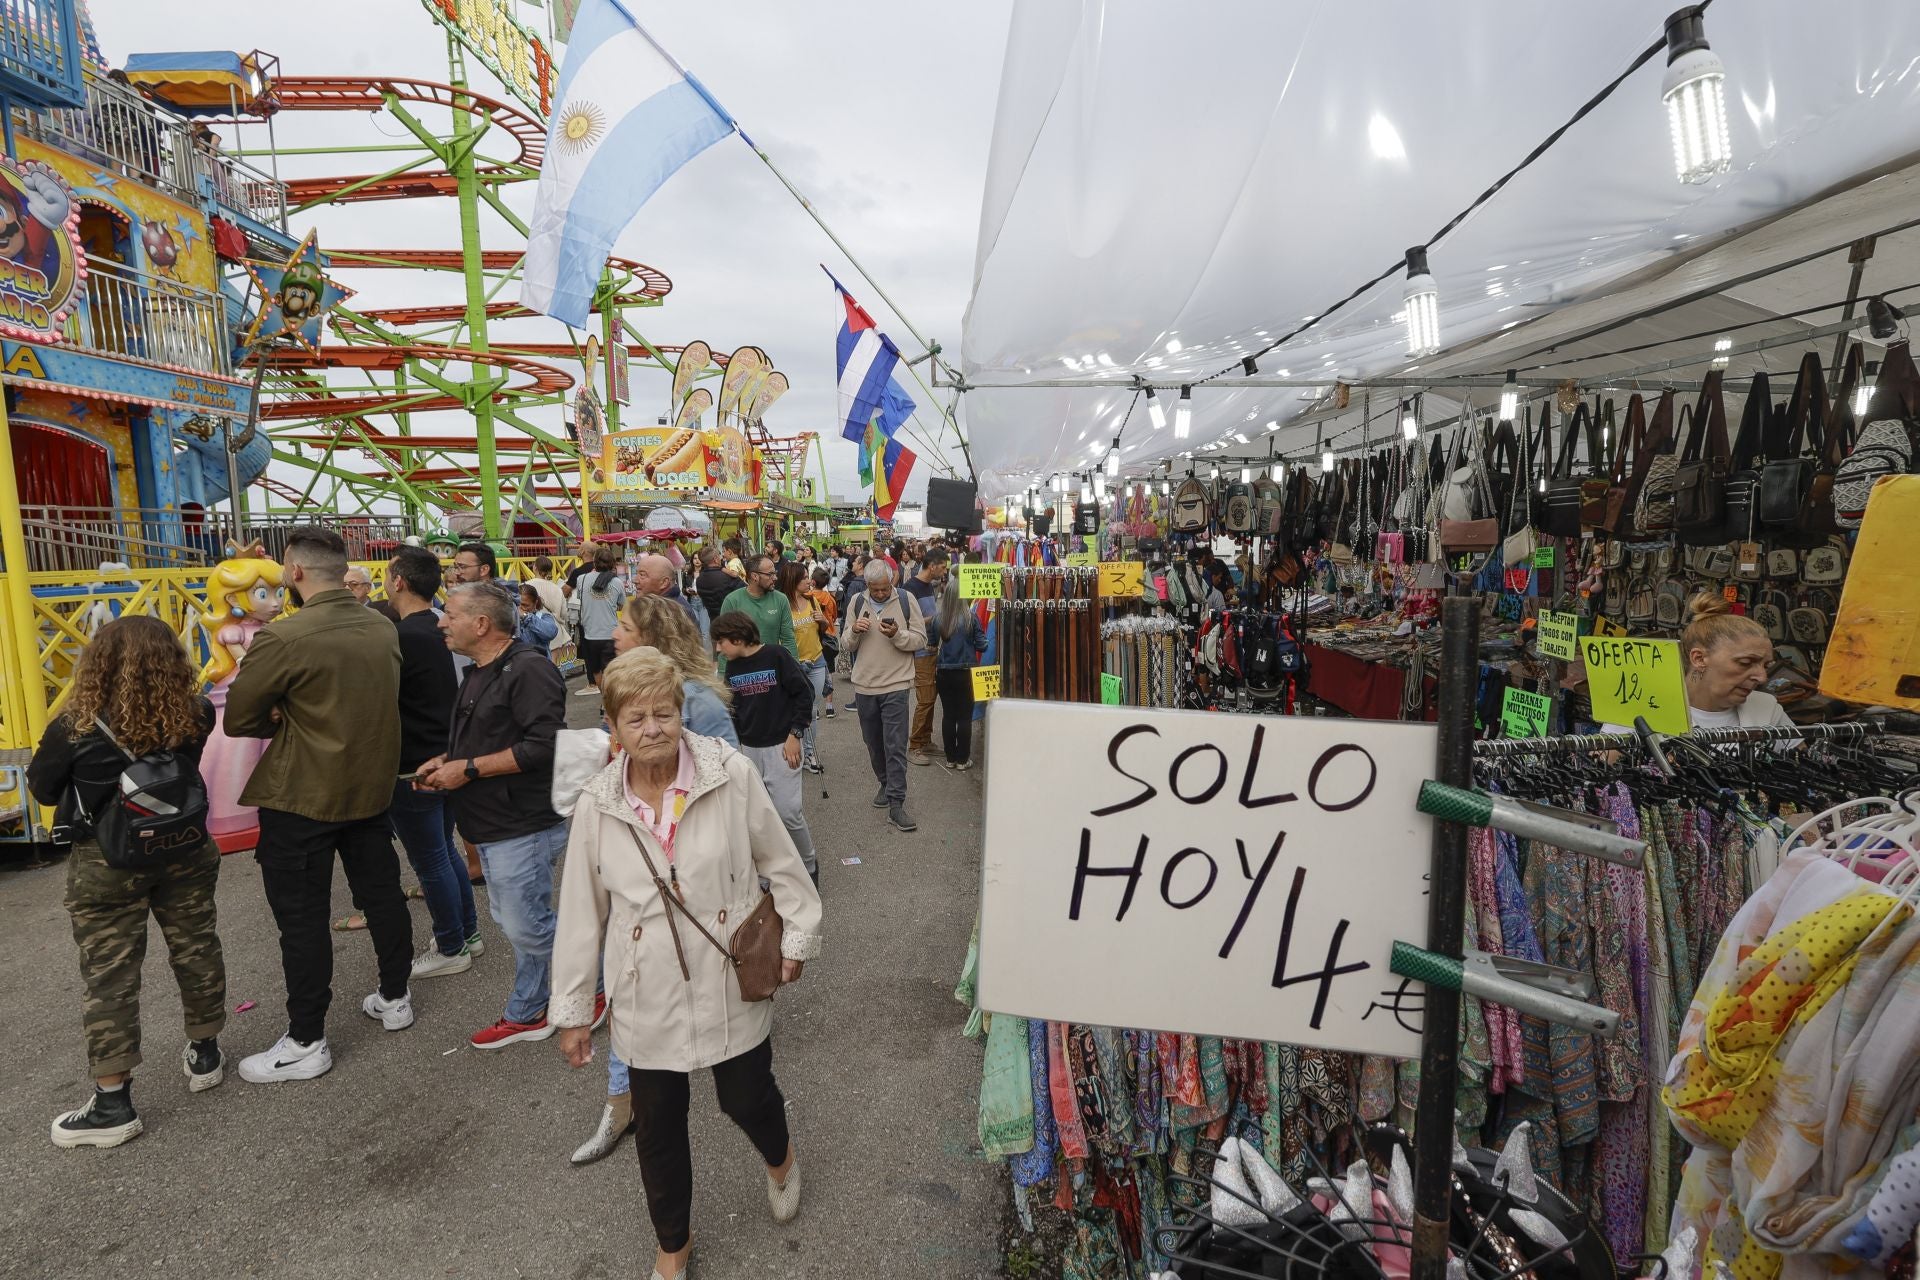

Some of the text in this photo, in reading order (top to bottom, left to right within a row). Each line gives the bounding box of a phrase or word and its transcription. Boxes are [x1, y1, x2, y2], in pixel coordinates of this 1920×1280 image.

[170, 388, 189, 402] LOS
[202, 381, 228, 395] TODOS
[612, 436, 662, 447] GOFRES
[616, 471, 700, 486] HOT DOGS
[1542, 612, 1575, 627] SE ACEPTAN
[1542, 627, 1573, 642] PAGOS CON
[1544, 642, 1568, 657] TARJETA
[1587, 642, 1663, 669] OFERTA
[976, 669, 1000, 677] CINTUR
[1614, 670, 1643, 705] 12
[1511, 691, 1544, 709] SABANAS
[1506, 701, 1546, 722] MULTIUSOS
[1090, 723, 1377, 817] SOLO
[144, 826, 202, 855] FILA
[1068, 827, 1287, 959] HOY
[1271, 865, 1370, 1030] 4
